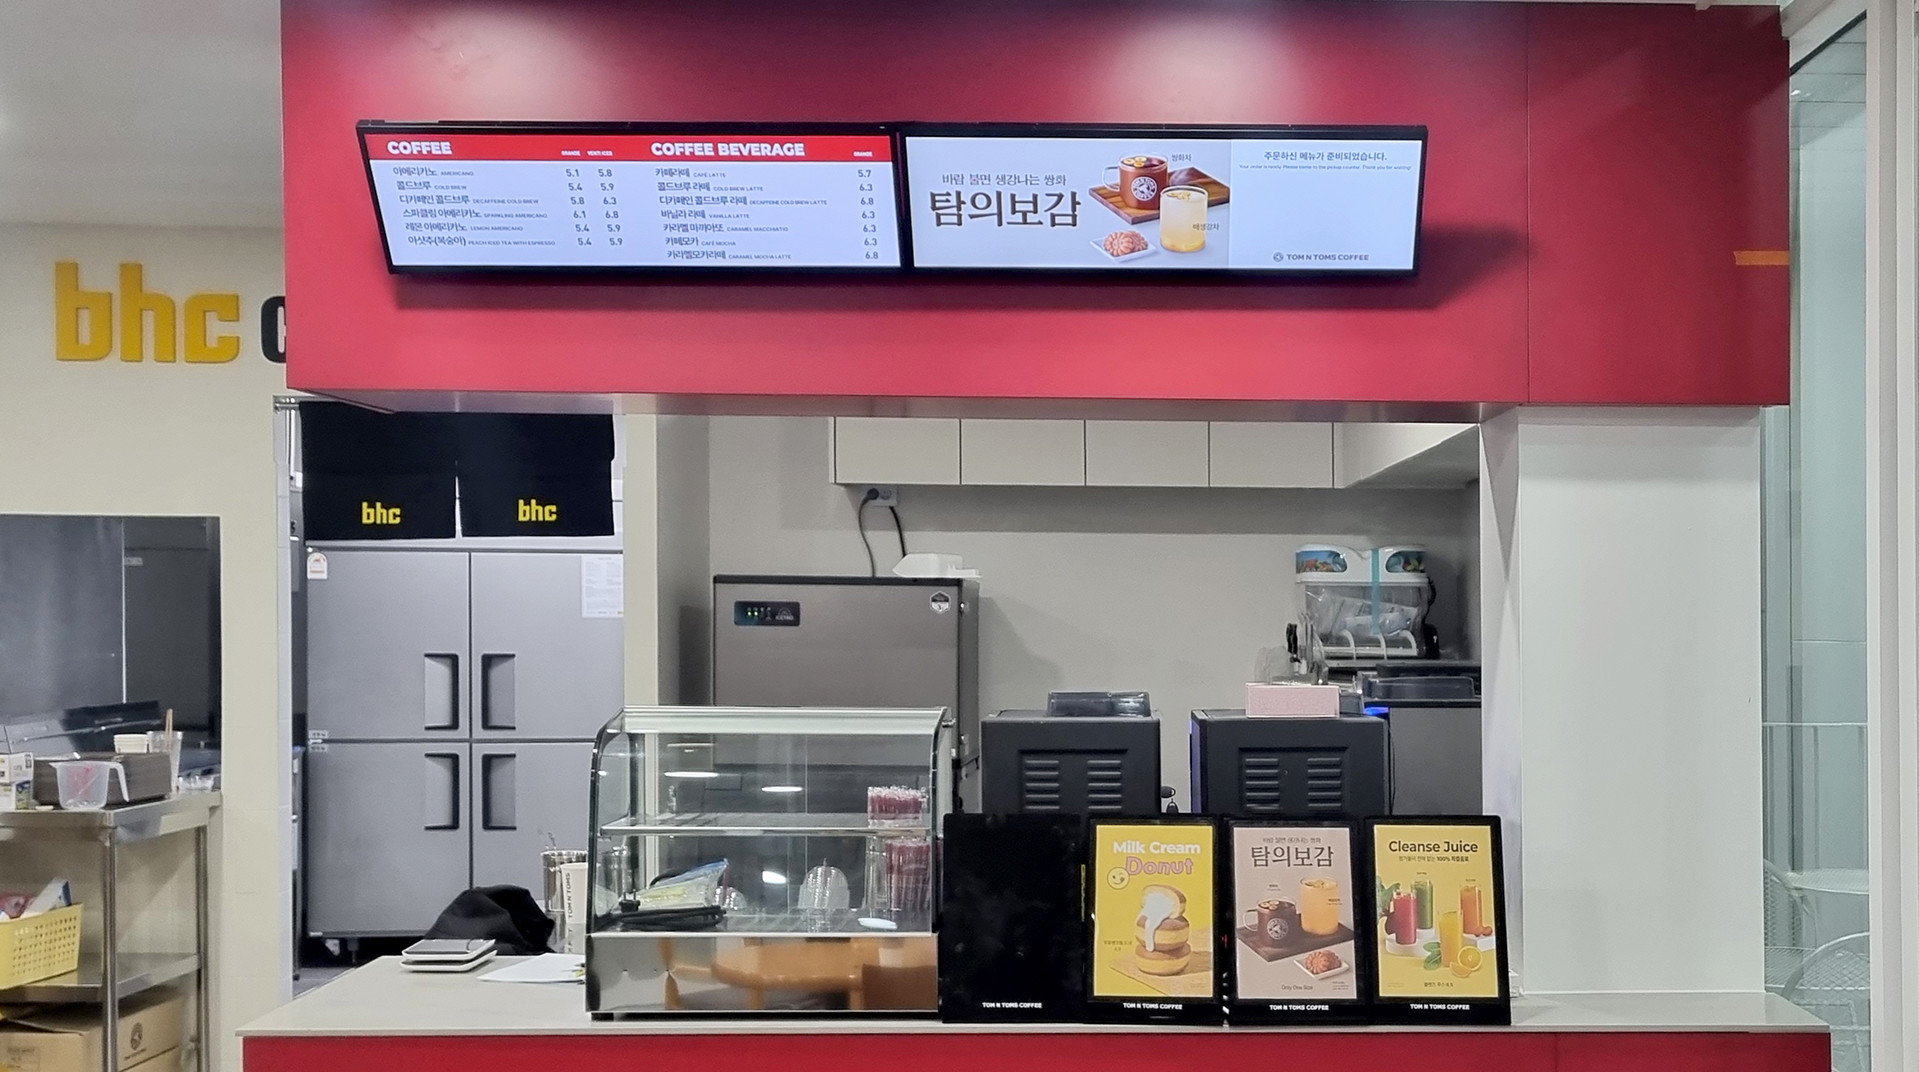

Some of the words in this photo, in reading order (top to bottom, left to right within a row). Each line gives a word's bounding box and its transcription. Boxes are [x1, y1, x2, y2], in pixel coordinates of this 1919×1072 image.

[387, 141, 453, 155] COFFEE
[651, 142, 715, 156] COFFEE
[717, 143, 805, 156] BEVERAGE
[1264, 152, 1297, 161] 주문하신
[1299, 152, 1324, 161] 메뉴가
[1327, 152, 1388, 161] 준비되었습니다.
[393, 167, 437, 176] 아메리카노
[566, 169, 580, 177] 5.1
[598, 169, 612, 177] 5.8
[857, 169, 871, 178] 5.7
[942, 174, 965, 186] 바람
[970, 174, 991, 186] 불면
[995, 174, 1040, 186] 생강나는
[1044, 174, 1067, 186] 쌍화
[568, 183, 583, 191] 5.4
[600, 183, 614, 191] 5.9
[859, 184, 873, 192] 6.3
[571, 197, 585, 205] 5.8
[603, 197, 617, 205] 6.3
[860, 197, 874, 205] 6.8
[437, 208, 482, 218] 아메리카노
[930, 190, 1082, 227] 탐의보감
[573, 211, 586, 219] 6.1
[605, 211, 619, 219] 6.8
[862, 211, 875, 219] 6.3
[423, 222, 468, 232] 아메리카노
[575, 224, 590, 233] 5.4
[607, 224, 621, 233] 5.9
[863, 225, 876, 233] 6.3
[577, 237, 592, 246] 5.4
[609, 237, 623, 246] 5.9
[864, 238, 877, 246] 6.3
[865, 251, 879, 260] 6.8
[55, 261, 240, 364] bhc
[362, 502, 401, 525] bhc
[517, 499, 557, 522] bhc
[1113, 840, 1145, 854] Milk
[1150, 841, 1201, 855] Cream
[1388, 840, 1440, 853] Cleanse
[1443, 840, 1479, 853] Juice
[1251, 846, 1334, 868] 탐의보감
[1125, 855, 1194, 876] Donut
